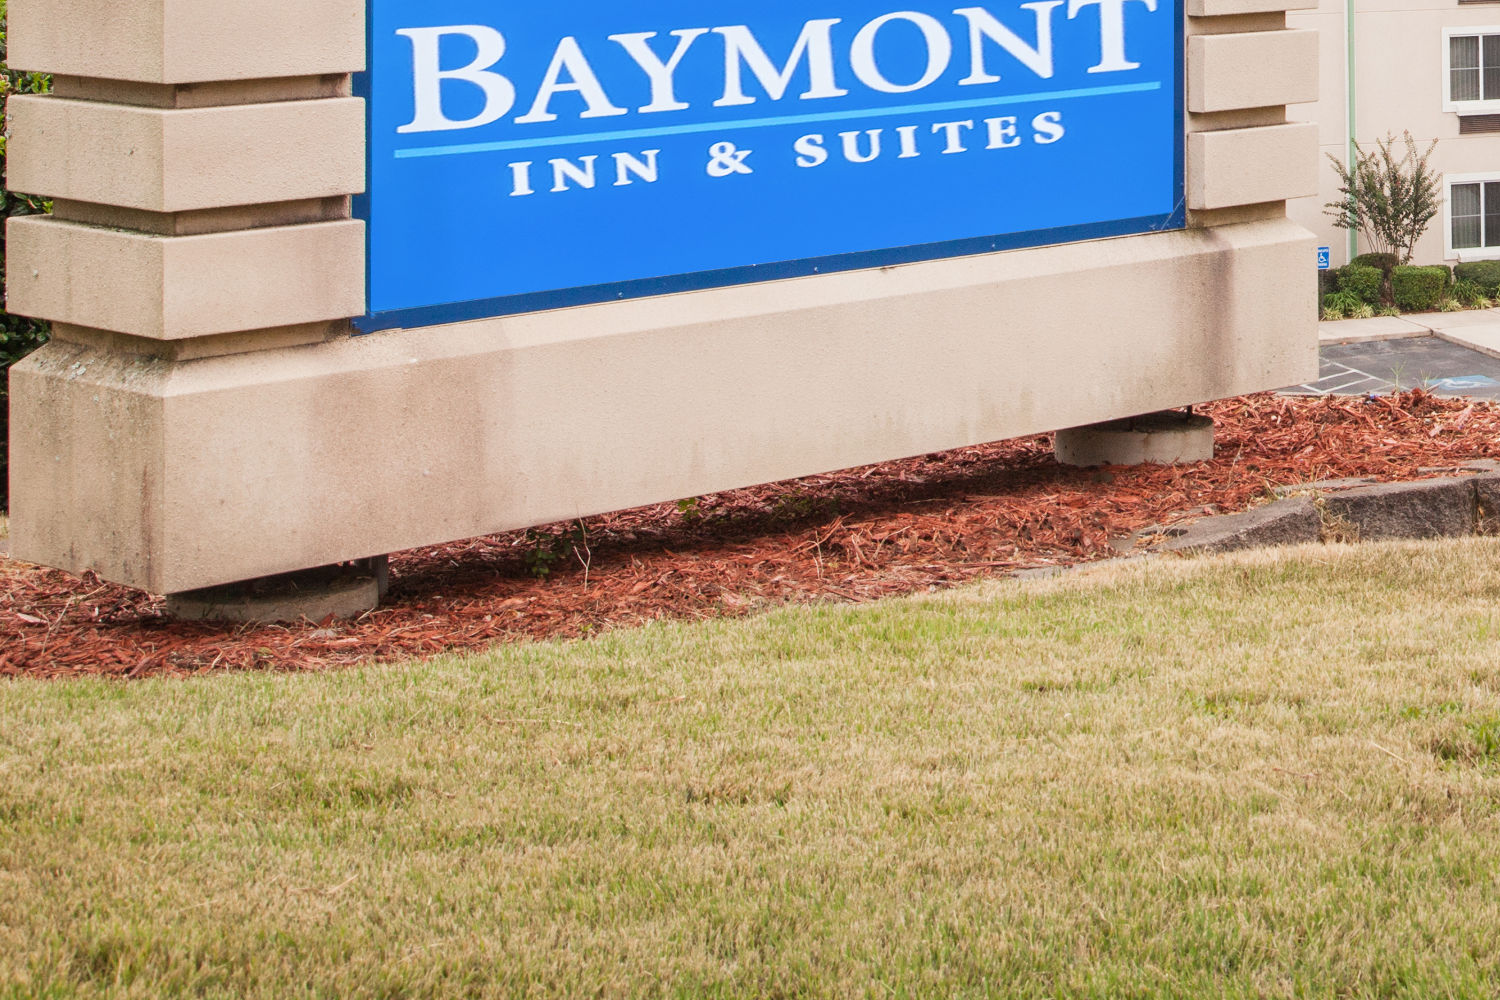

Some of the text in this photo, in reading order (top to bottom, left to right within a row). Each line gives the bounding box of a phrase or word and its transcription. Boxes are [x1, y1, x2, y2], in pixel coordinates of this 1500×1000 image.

[508, 111, 1066, 197] INN & SUITES
